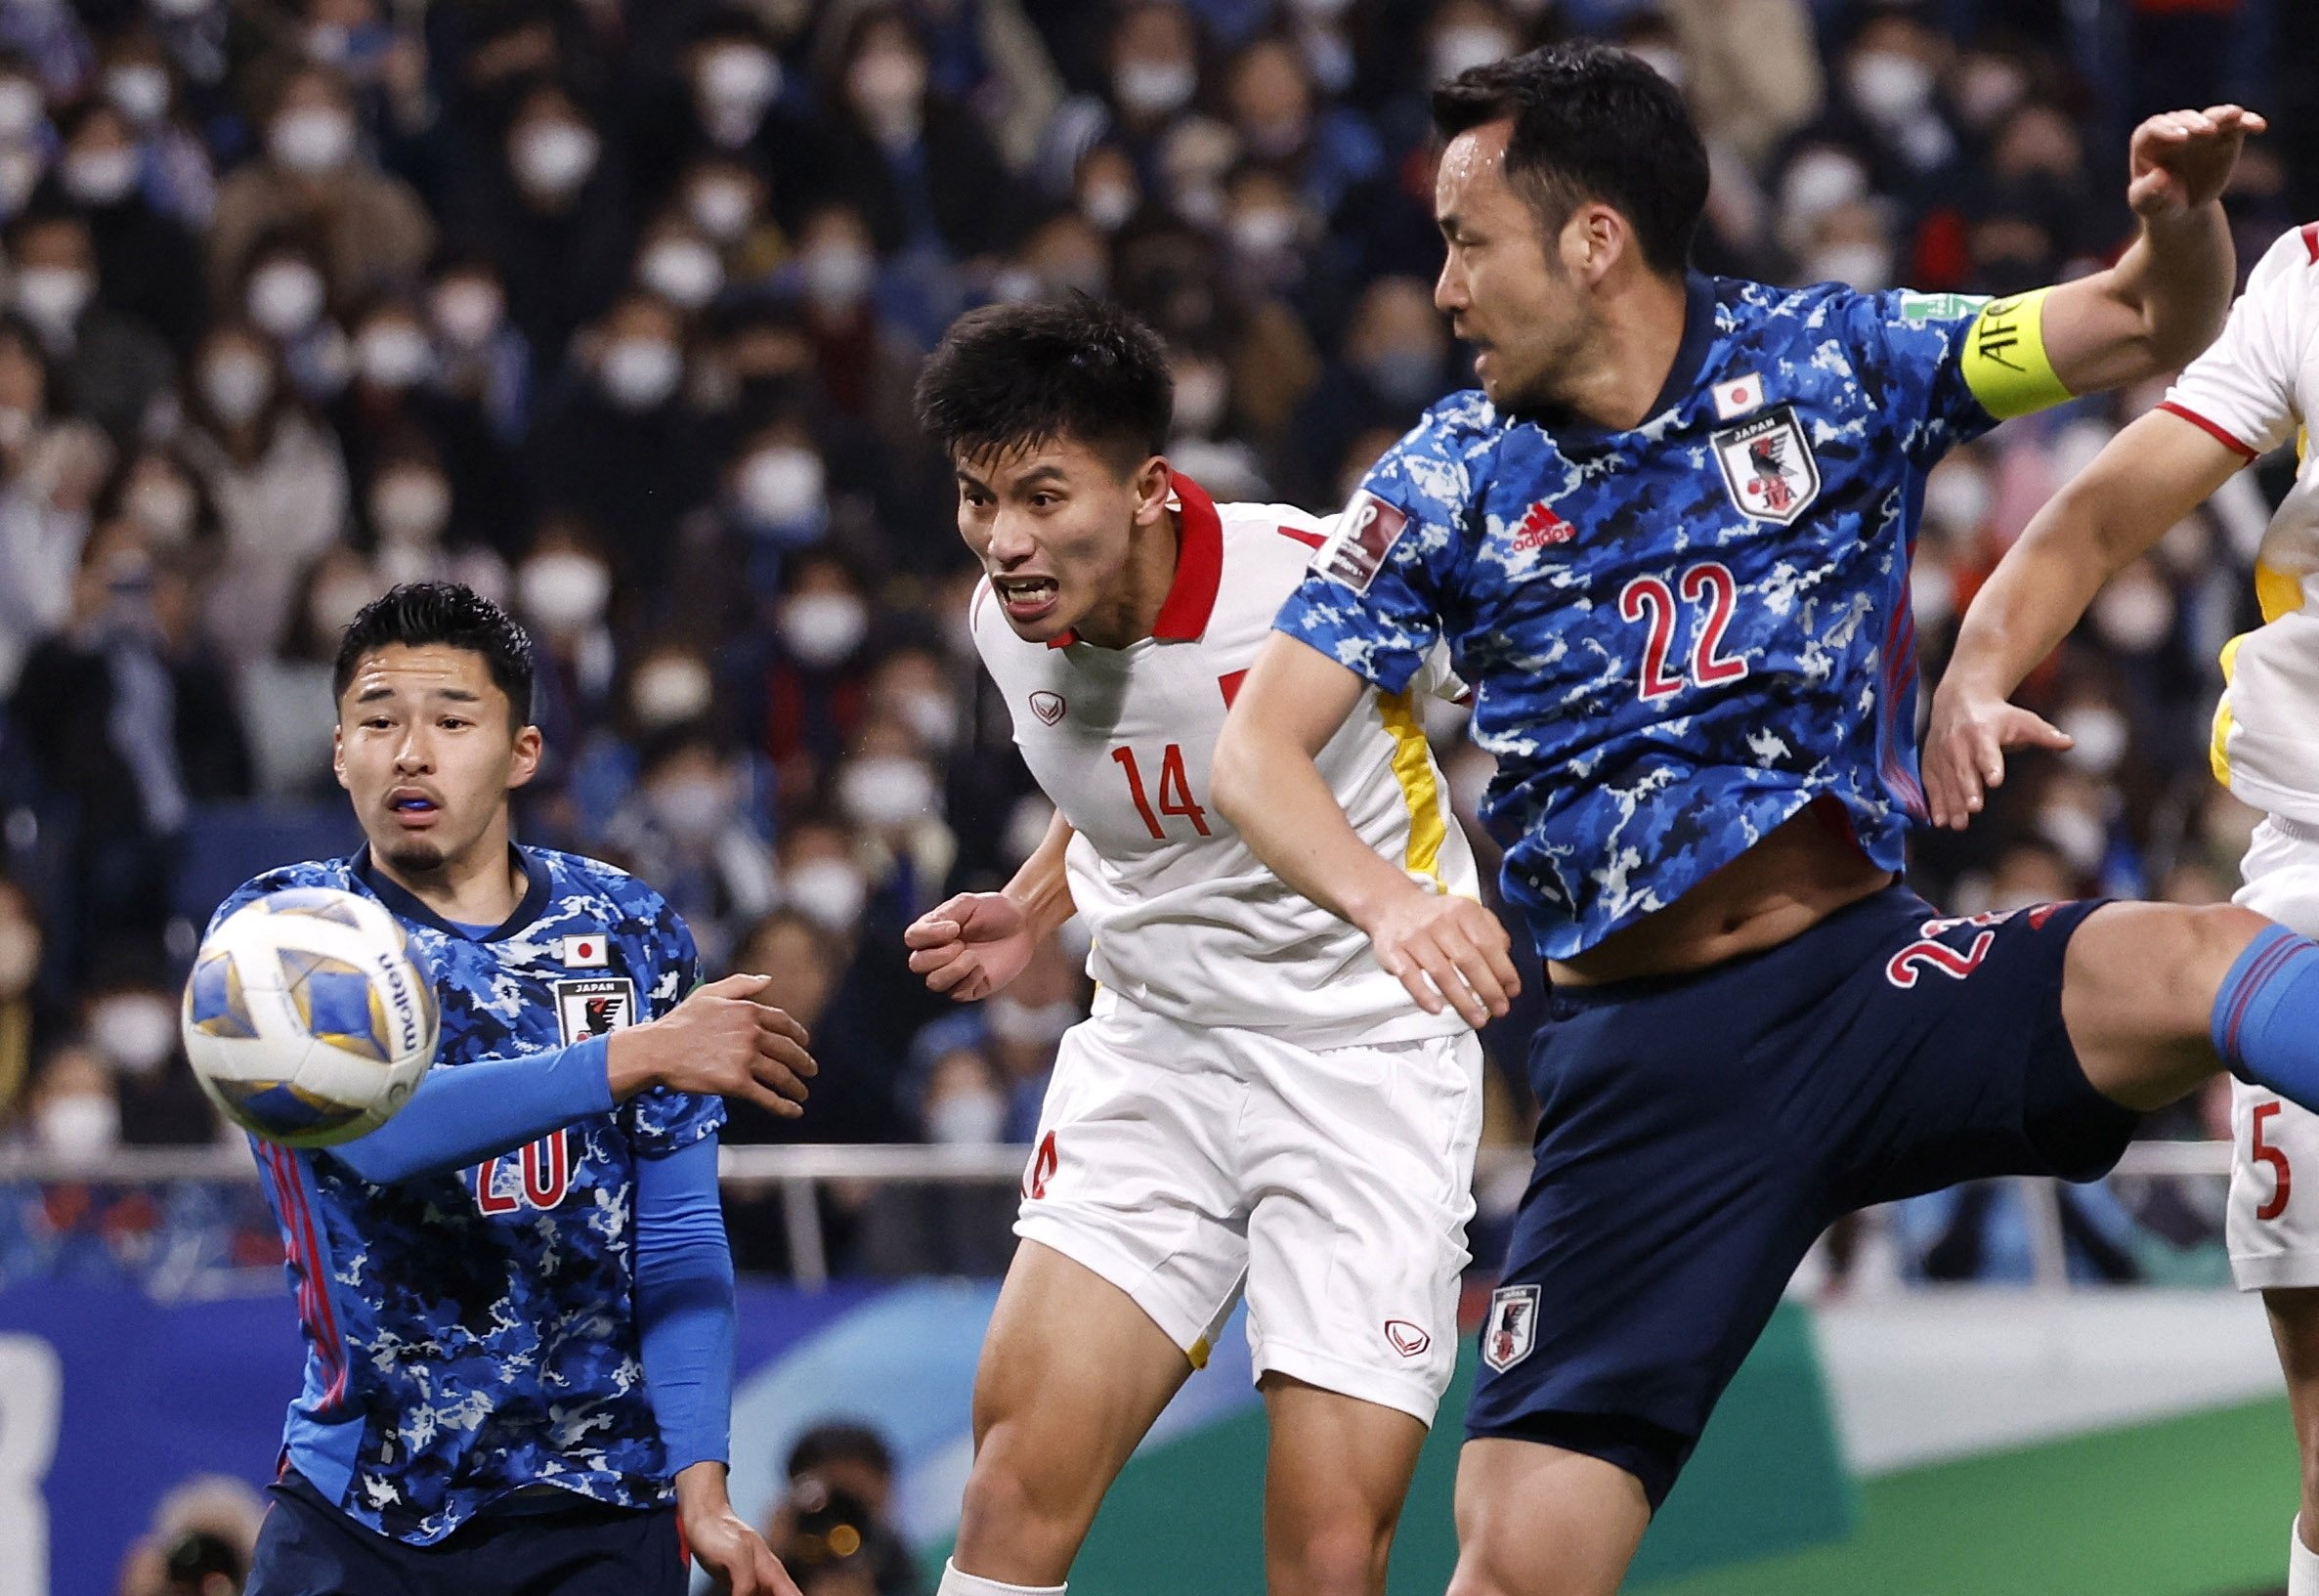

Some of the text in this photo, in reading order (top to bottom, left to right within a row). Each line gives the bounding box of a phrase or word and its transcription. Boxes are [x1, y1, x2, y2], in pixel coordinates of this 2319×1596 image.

[1734, 417, 1776, 442] JAPAN
[1513, 524, 1575, 551] adidas
[1619, 560, 1749, 703] 22
[1111, 744, 1212, 840] 14
[378, 953, 416, 1051] molten
[575, 982, 615, 993] JAPAN
[2253, 1100, 2292, 1221] 5
